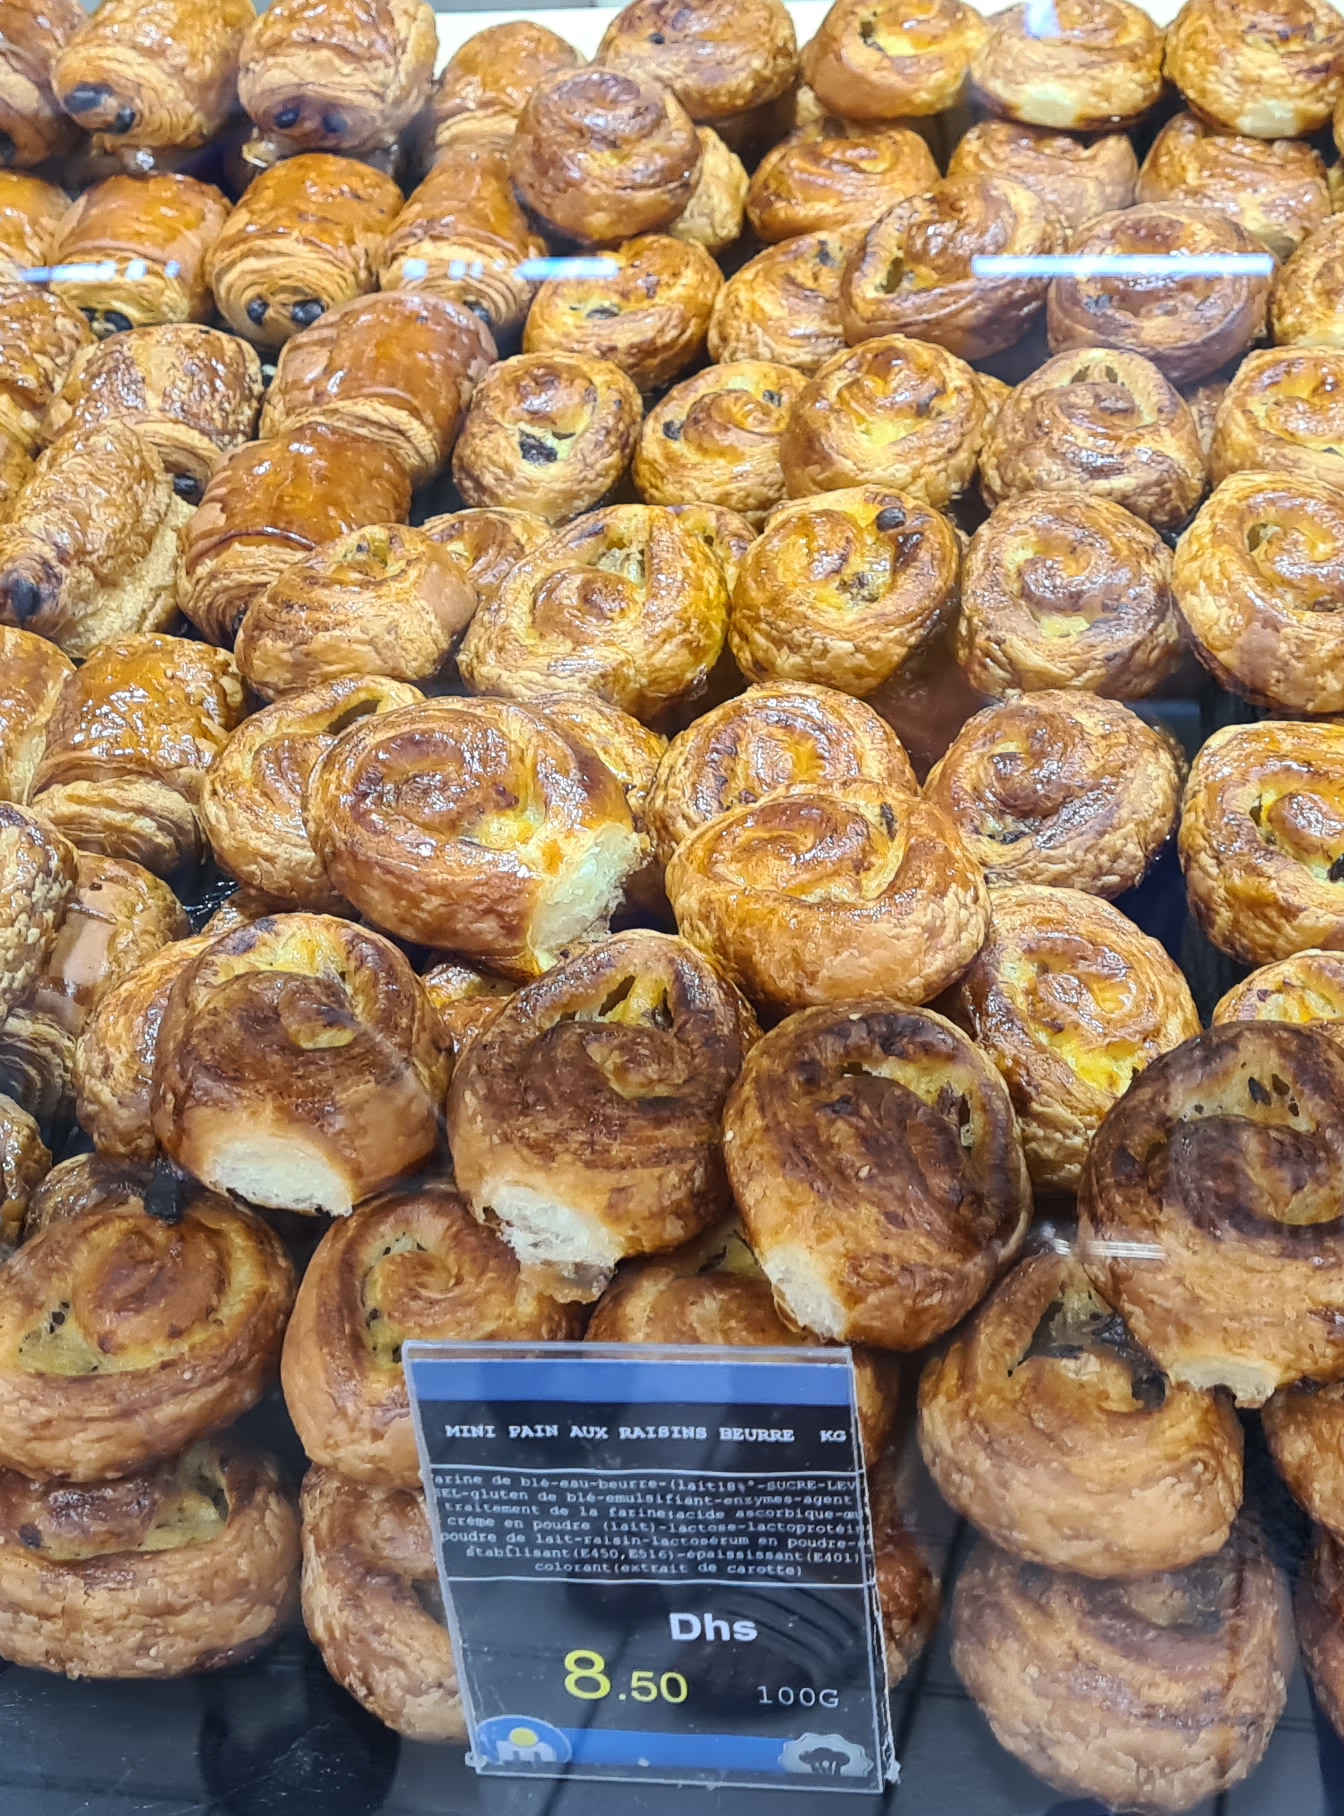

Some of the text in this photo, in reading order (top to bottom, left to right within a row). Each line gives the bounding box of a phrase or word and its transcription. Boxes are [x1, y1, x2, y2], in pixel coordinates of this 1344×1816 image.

[445, 1425, 847, 1443] MINI PAIN AUX RAISINS BEURRE KG
[432, 1474, 482, 1484] arine
[492, 1474, 511, 1485] de
[538, 1489, 557, 1501] de
[445, 1502, 540, 1515] traitement
[550, 1505, 569, 1516] de
[580, 1506, 598, 1517] la
[504, 1518, 524, 1528] en
[533, 1519, 590, 1531] poudre
[506, 1532, 525, 1543] de
[536, 1534, 749, 1546] lait-raisin-lactosérum
[758, 1537, 778, 1546] en
[534, 1562, 802, 1576] colorant(extrait de carotte)
[669, 1612, 757, 1642] Dhs
[758, 1685, 839, 1708] 100G
